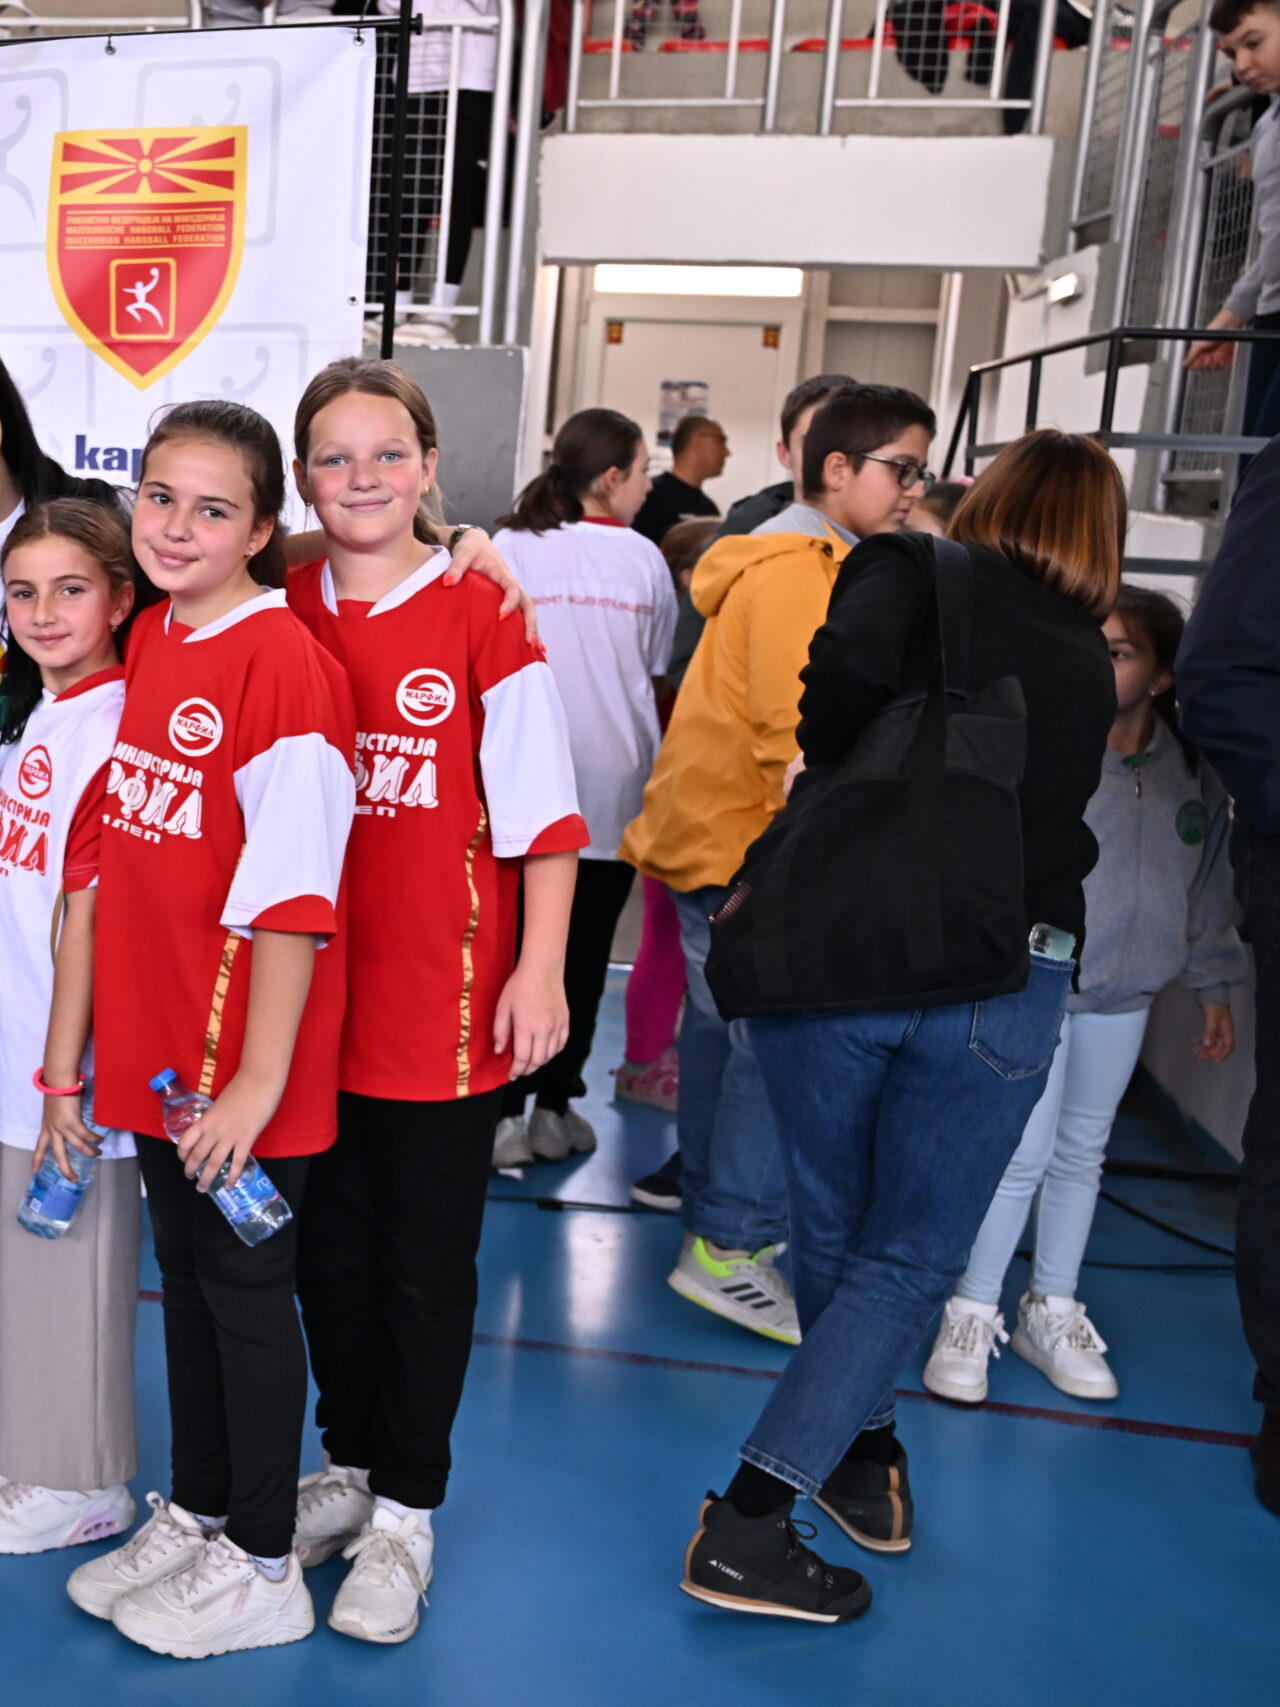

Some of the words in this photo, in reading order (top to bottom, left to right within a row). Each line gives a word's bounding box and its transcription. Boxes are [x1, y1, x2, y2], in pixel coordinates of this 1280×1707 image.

[404, 689, 449, 705] МАРФИЛ
[175, 716, 215, 738] МАРФИЛ
[112, 741, 204, 789] ИНДУСТРИЈА
